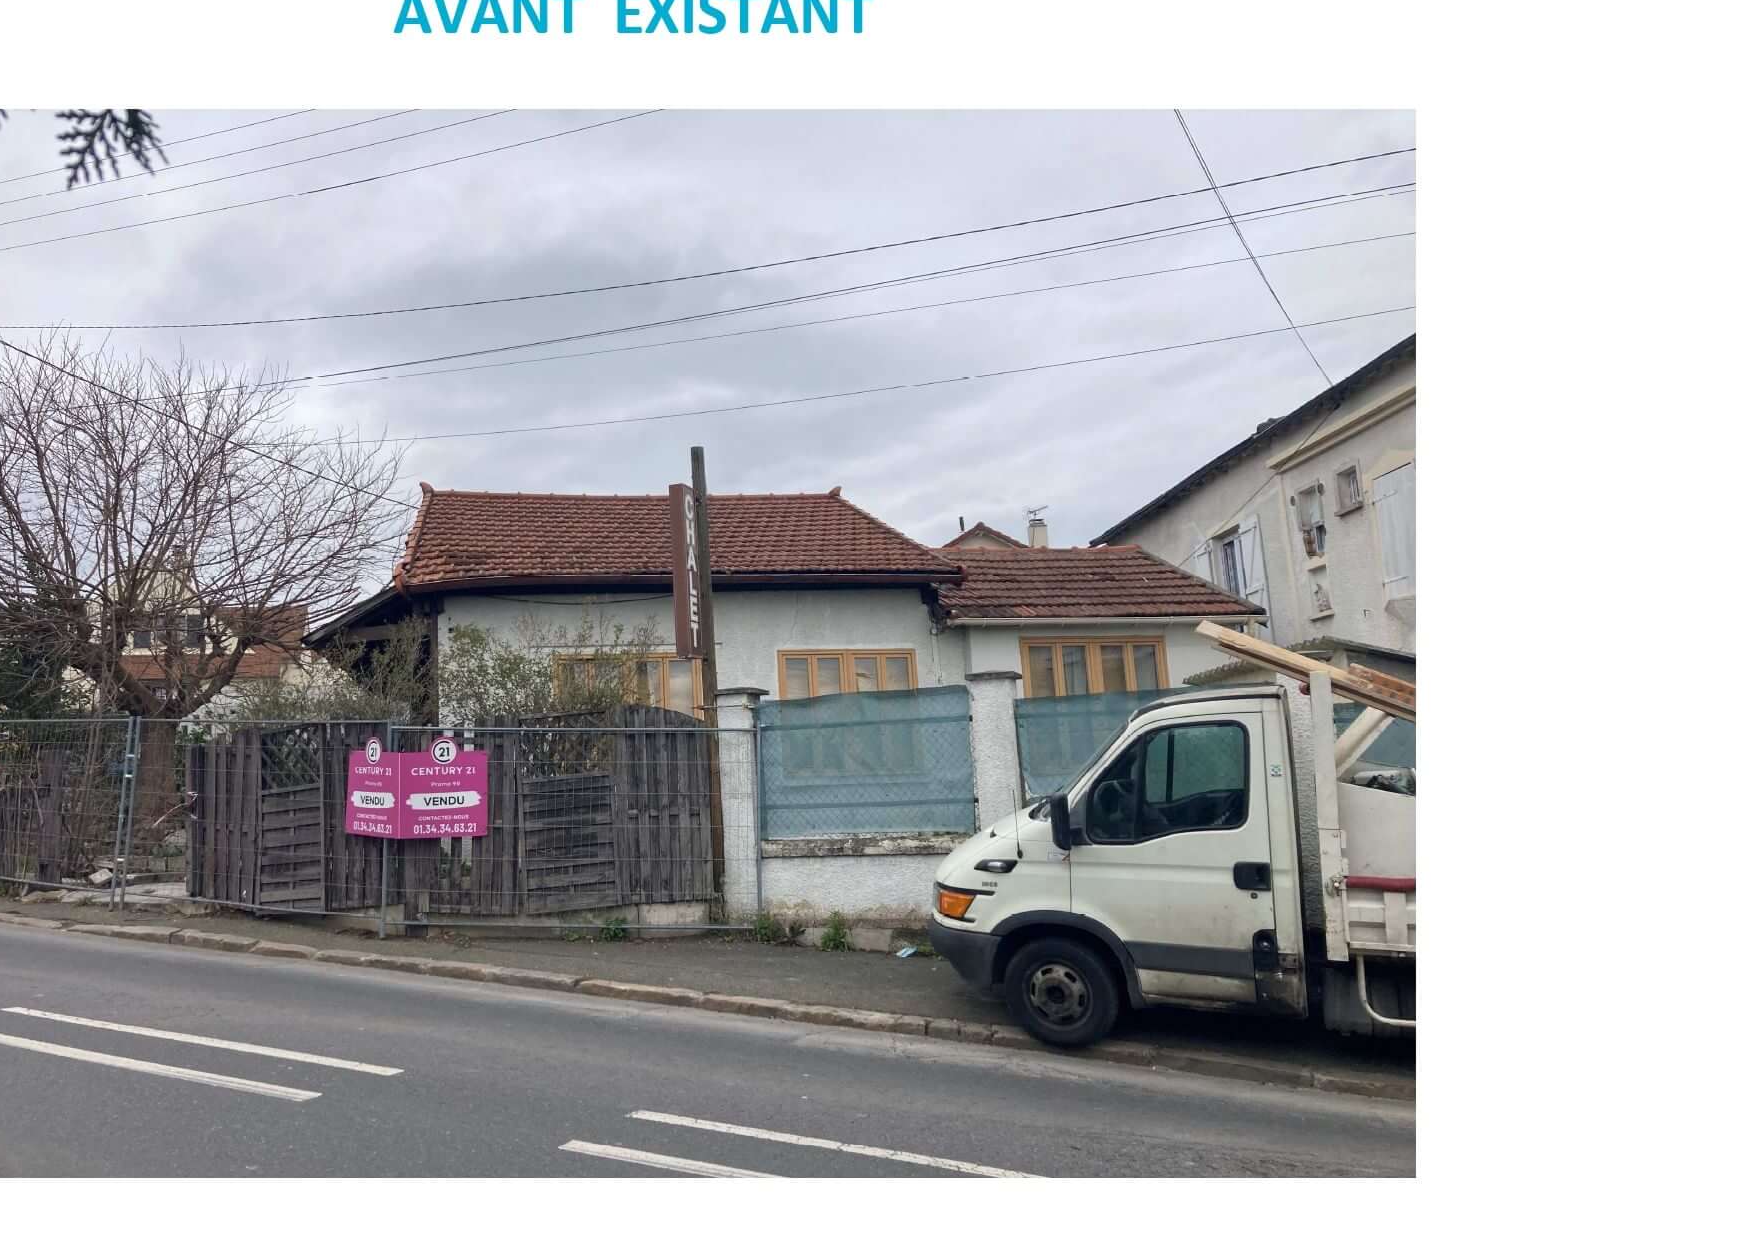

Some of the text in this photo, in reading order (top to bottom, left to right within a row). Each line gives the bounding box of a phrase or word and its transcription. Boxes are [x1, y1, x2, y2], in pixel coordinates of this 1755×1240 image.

[684, 493, 699, 648] CHALET
[370, 747, 377, 757] 21
[438, 747, 450, 757] 21
[355, 766, 392, 776] CENTURY 21
[411, 767, 476, 776] CENTURY 21
[360, 796, 385, 806] VENDU
[424, 796, 465, 806] VENDU
